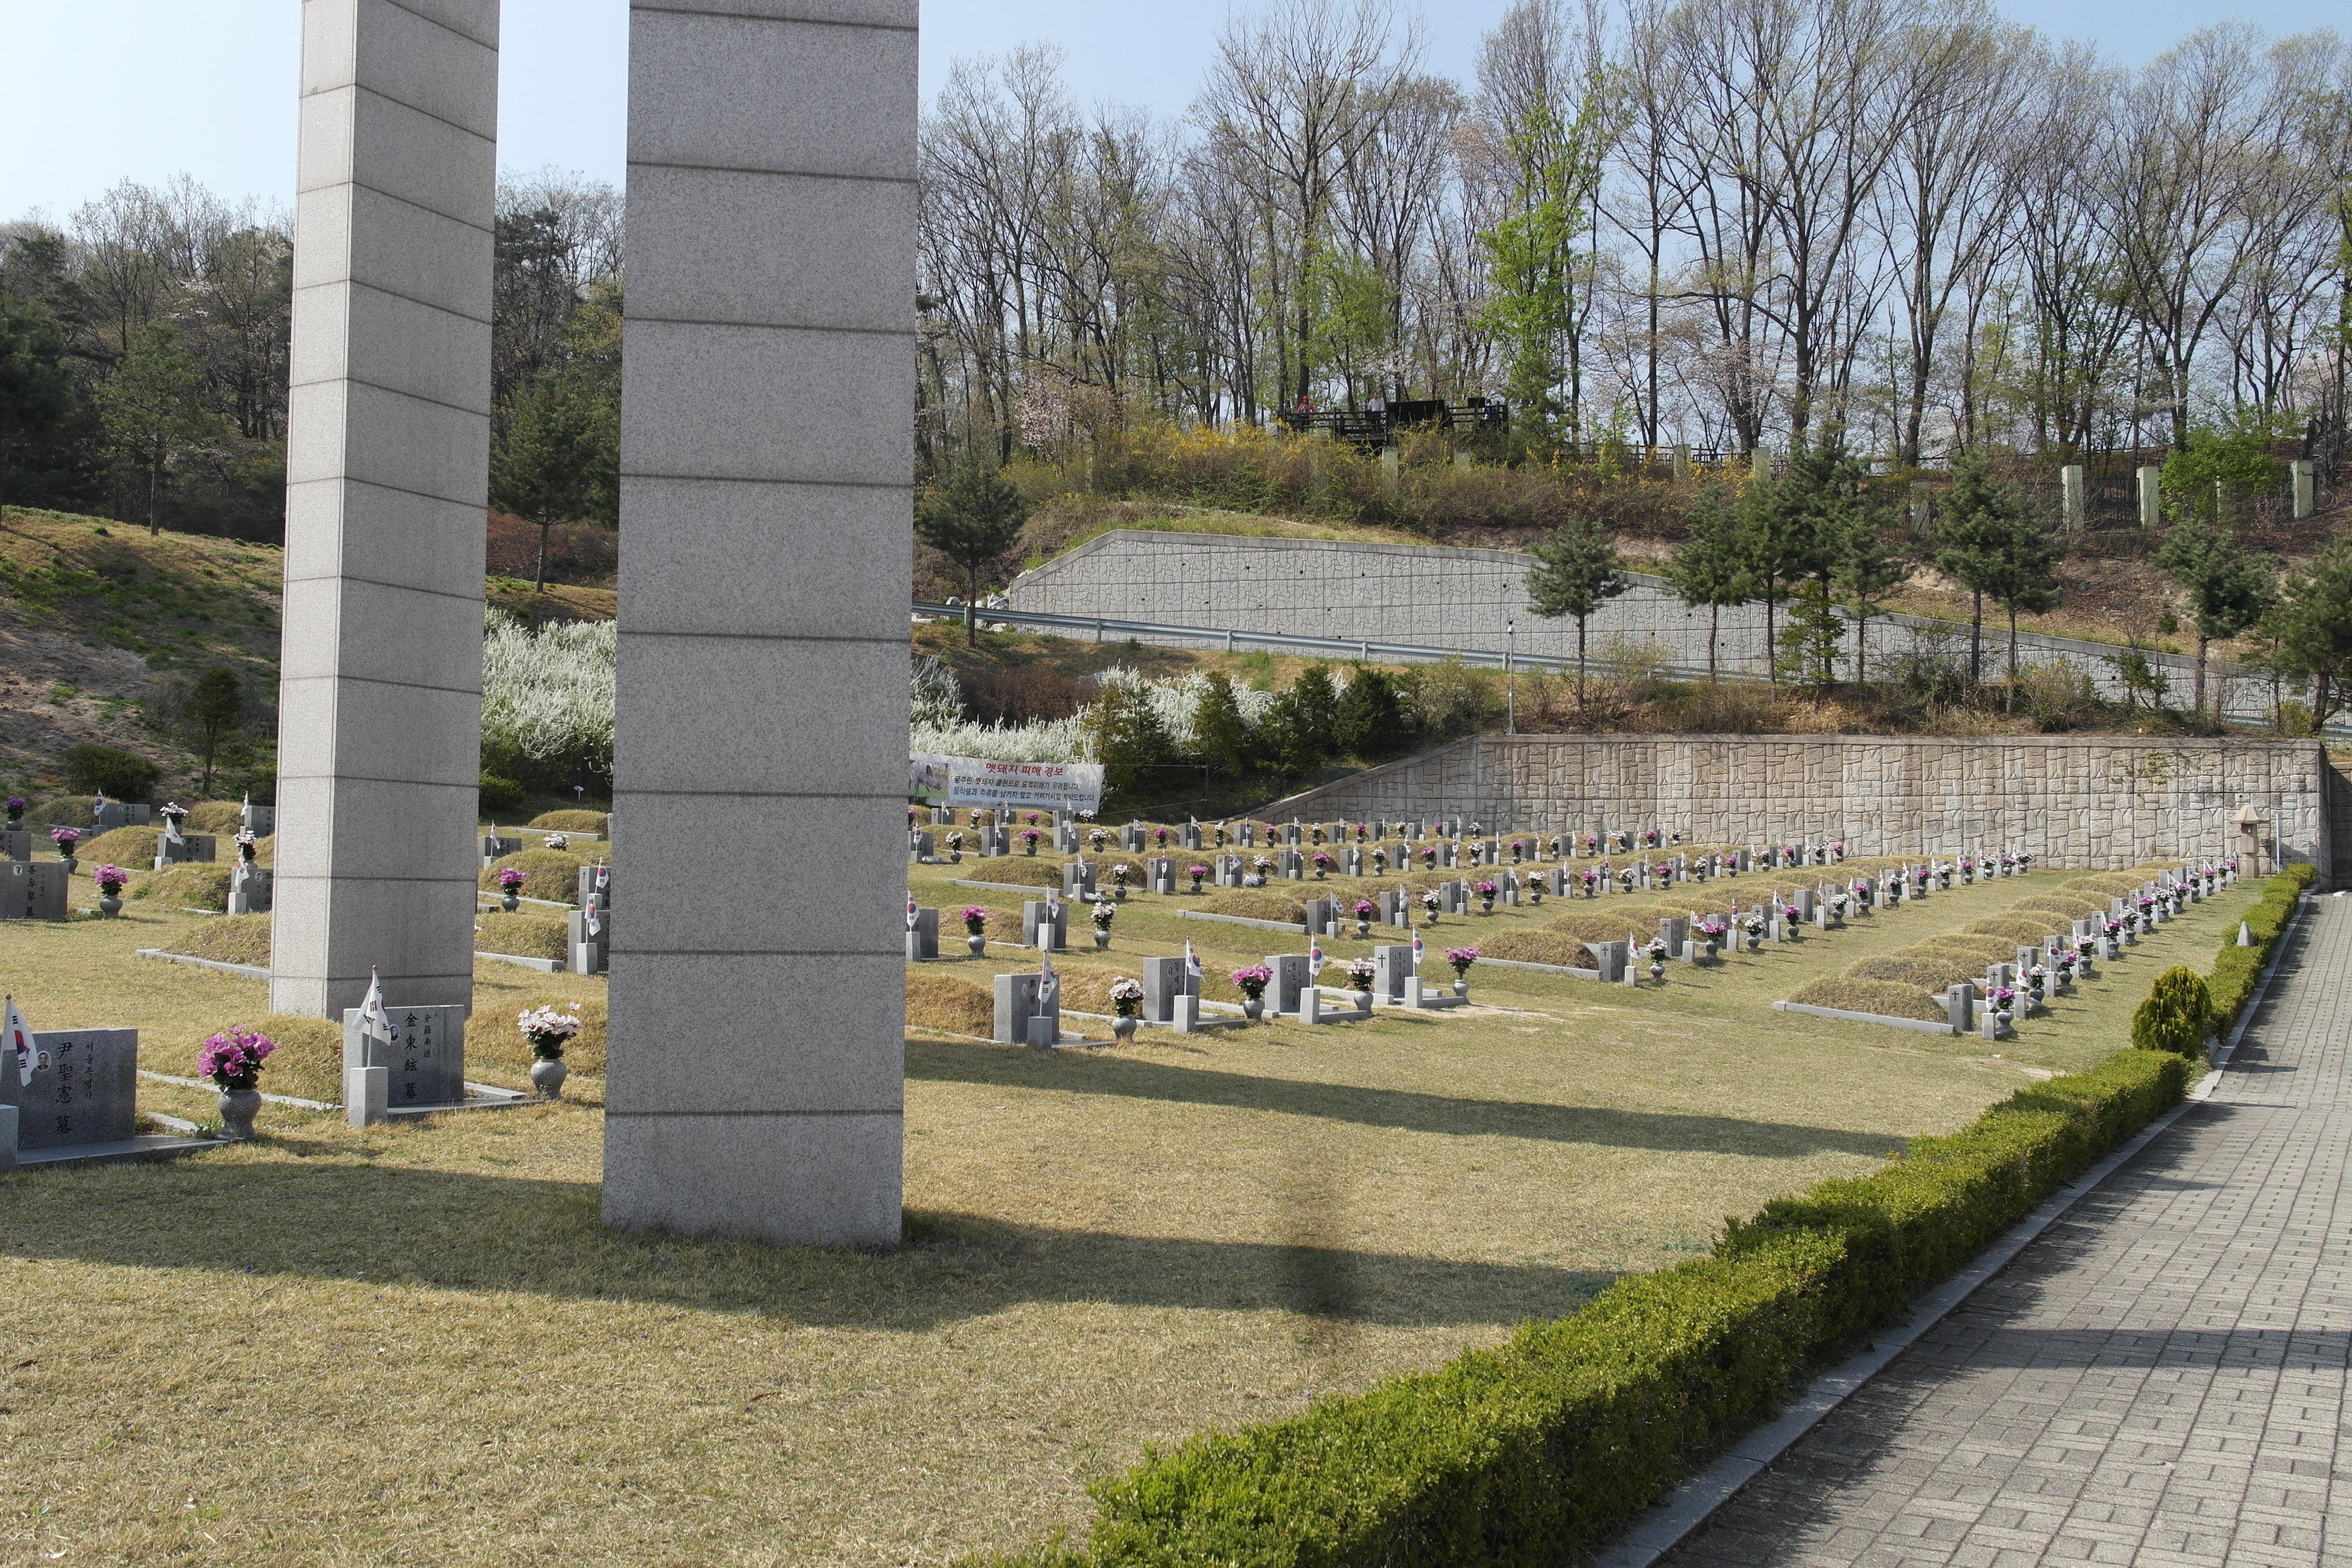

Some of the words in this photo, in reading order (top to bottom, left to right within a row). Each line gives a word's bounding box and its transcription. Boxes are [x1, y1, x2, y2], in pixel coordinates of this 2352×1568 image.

[986, 763, 1018, 775] 멧돼지
[1021, 766, 1041, 776] 피해
[1044, 766, 1063, 777] 경보
[954, 775, 973, 785] 굶주린
[975, 777, 994, 786] 멧돼지
[996, 778, 1020, 787] 출현으로
[1021, 781, 1050, 789] 묘역피해가
[1052, 782, 1080, 790] 우려됩니다.
[953, 787, 977, 796] 음식물과
[980, 789, 998, 798] 주류를
[1000, 790, 1018, 798] 남기지
[1034, 792, 1061, 801] 가져가시길
[1063, 793, 1096, 802] 부탁드립니다.
[423, 1014, 432, 1058] 全羅南道
[83, 1041, 94, 1100] 서울특별시
